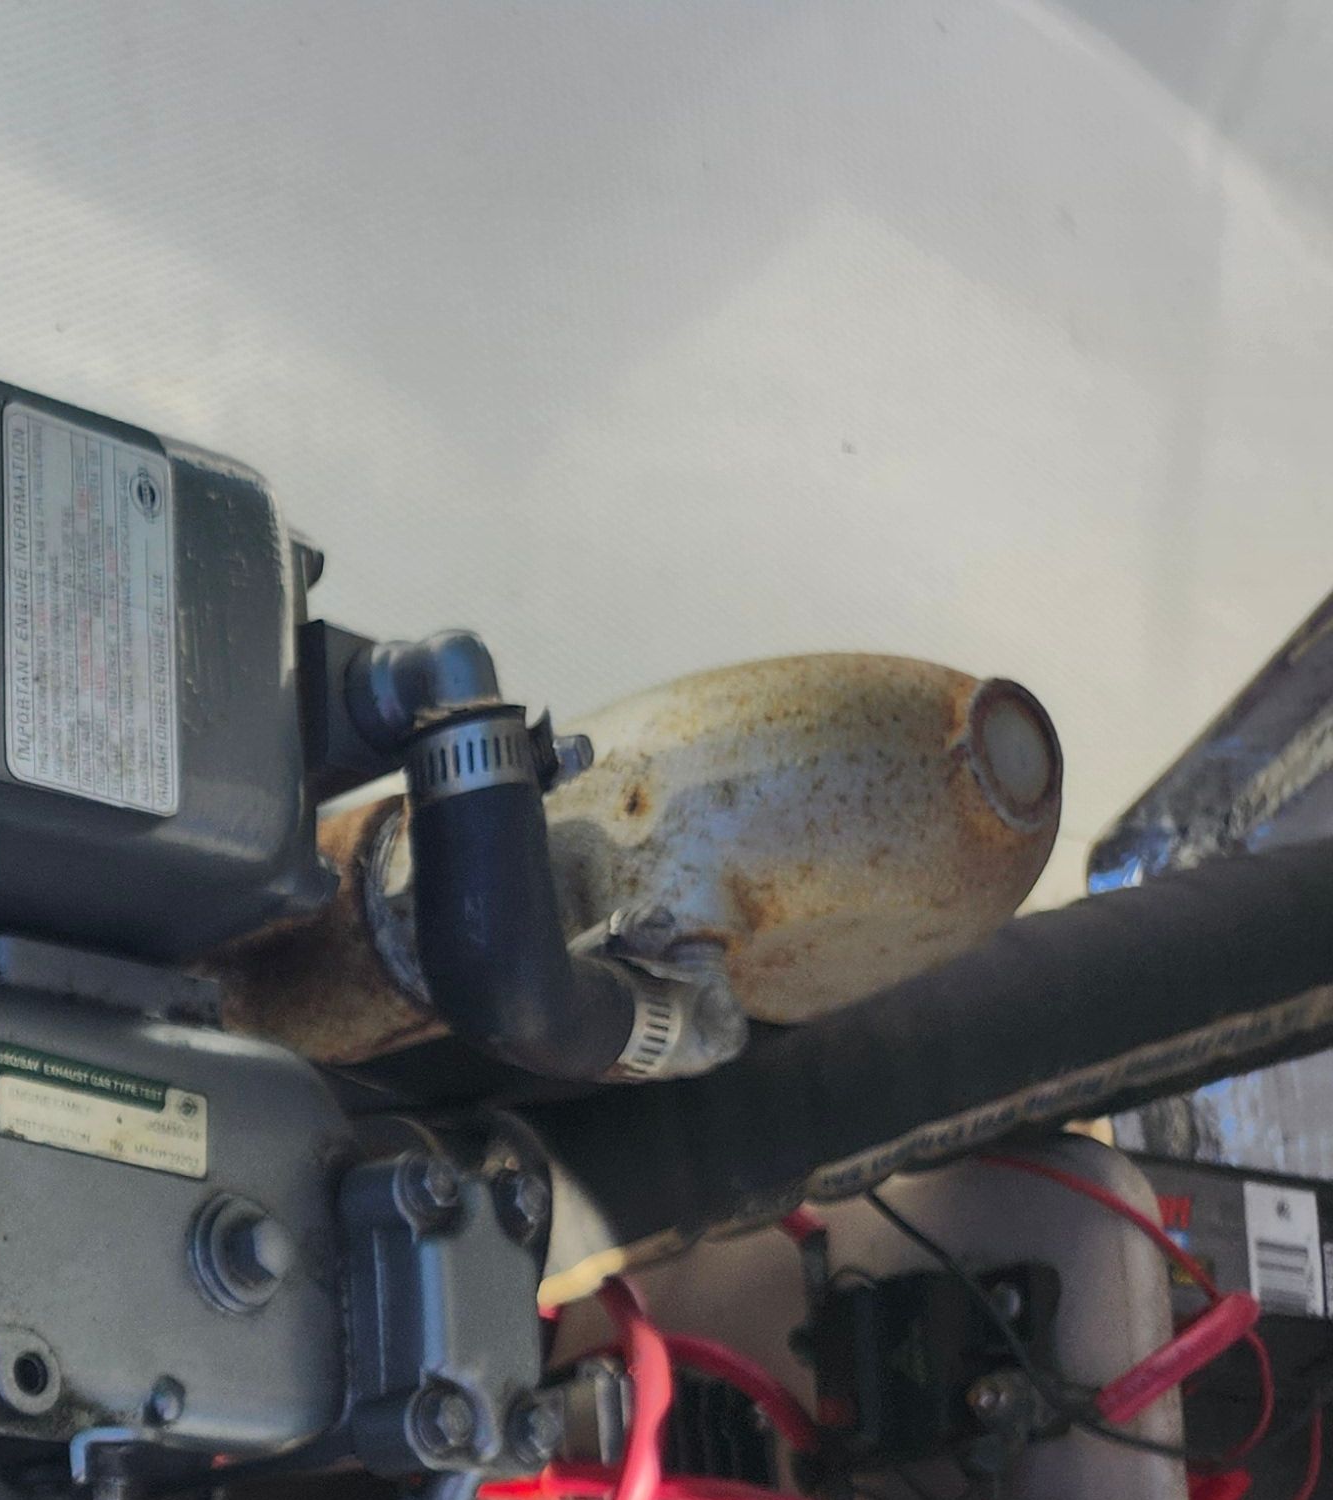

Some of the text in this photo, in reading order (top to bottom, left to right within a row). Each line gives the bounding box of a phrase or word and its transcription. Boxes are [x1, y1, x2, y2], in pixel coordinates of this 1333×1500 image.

[11, 425, 30, 763] IMPORTANT ENGINE INFORMATION
